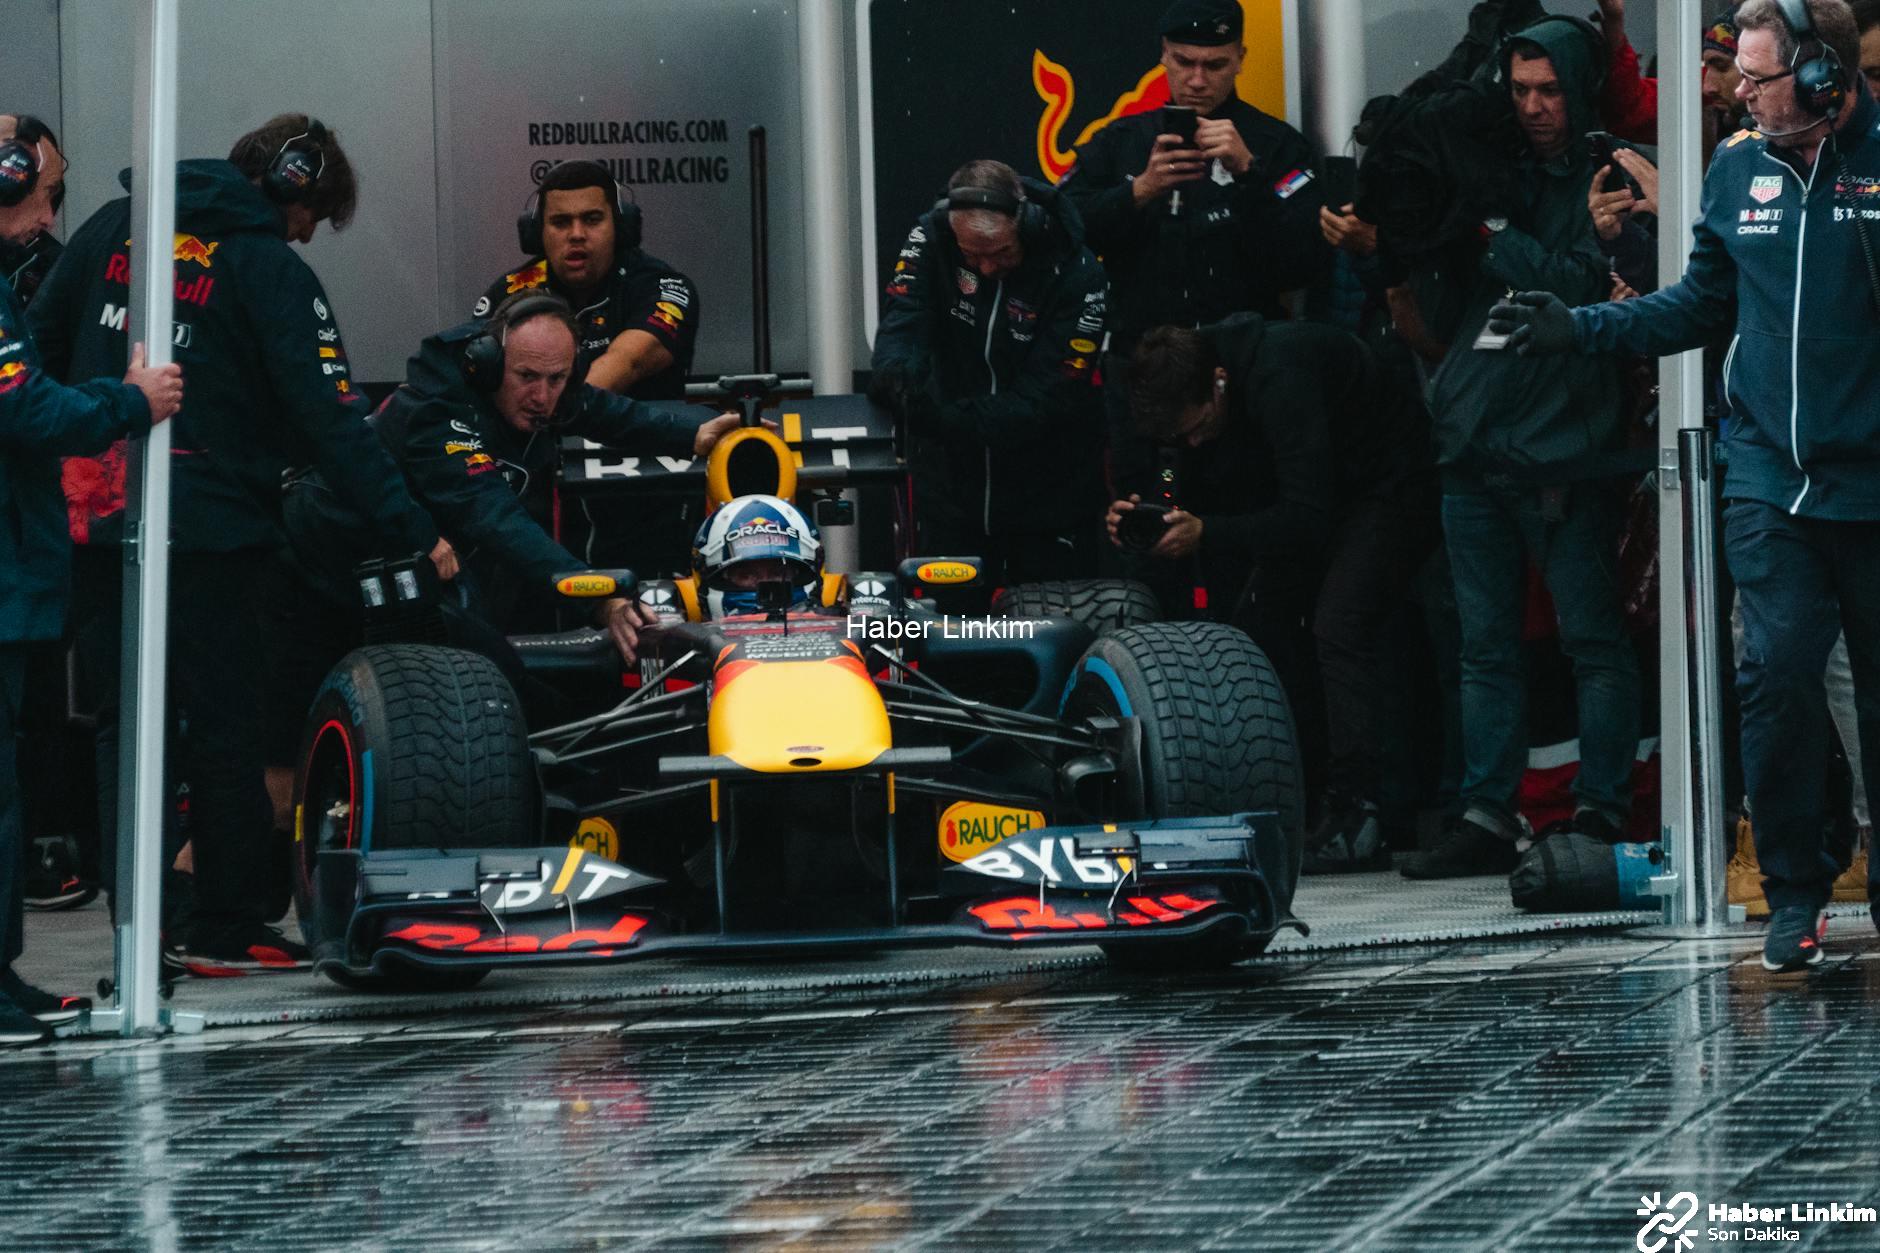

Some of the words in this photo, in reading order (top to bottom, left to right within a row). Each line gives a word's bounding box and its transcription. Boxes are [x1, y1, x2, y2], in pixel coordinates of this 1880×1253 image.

[528, 120, 728, 145] REDBULLRACING.COM
[530, 156, 729, 186] @ULLRACING
[1758, 179, 1780, 187] TAG
[1739, 209, 1769, 222] Mobil
[1737, 225, 1779, 235] ORACLE
[173, 269, 215, 306] ull
[725, 523, 798, 542] ORACLE
[933, 567, 969, 578] RAUCH
[573, 581, 609, 592] RAUCH
[958, 813, 1031, 845] RAUCH
